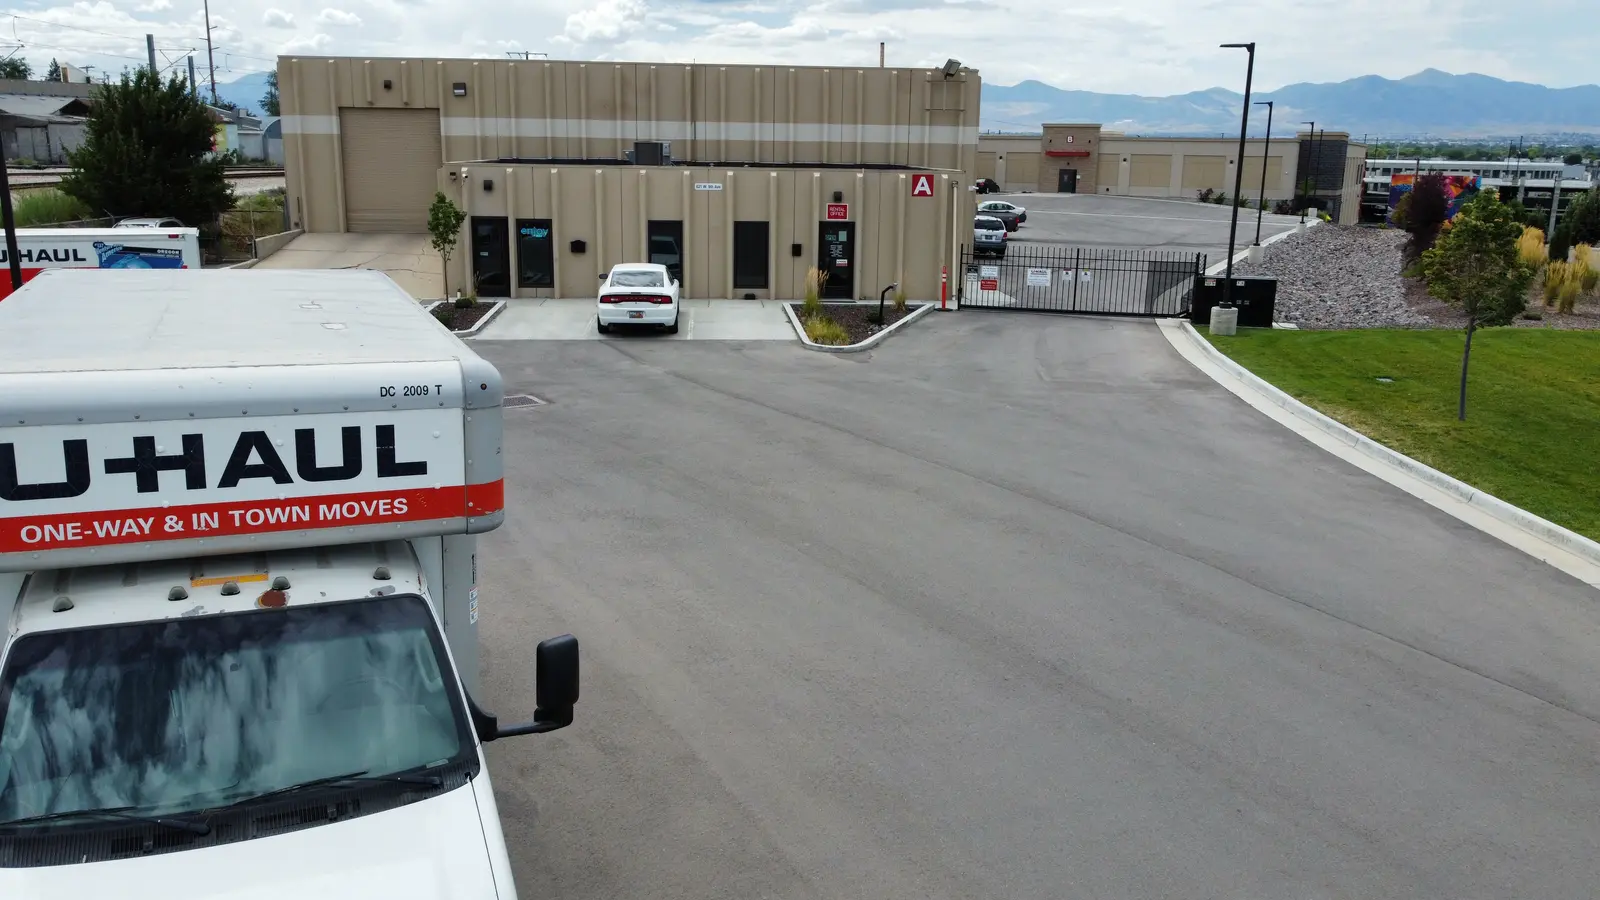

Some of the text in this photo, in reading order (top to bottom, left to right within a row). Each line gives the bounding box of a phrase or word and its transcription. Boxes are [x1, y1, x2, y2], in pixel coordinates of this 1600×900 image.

[913, 176, 932, 195] A
[0, 248, 87, 263] HAUL
[380, 384, 443, 398] DC 2009 T
[0, 424, 428, 502] U-HAUL
[20, 497, 409, 544] ONE-WAY & IN TOWN MOVES
